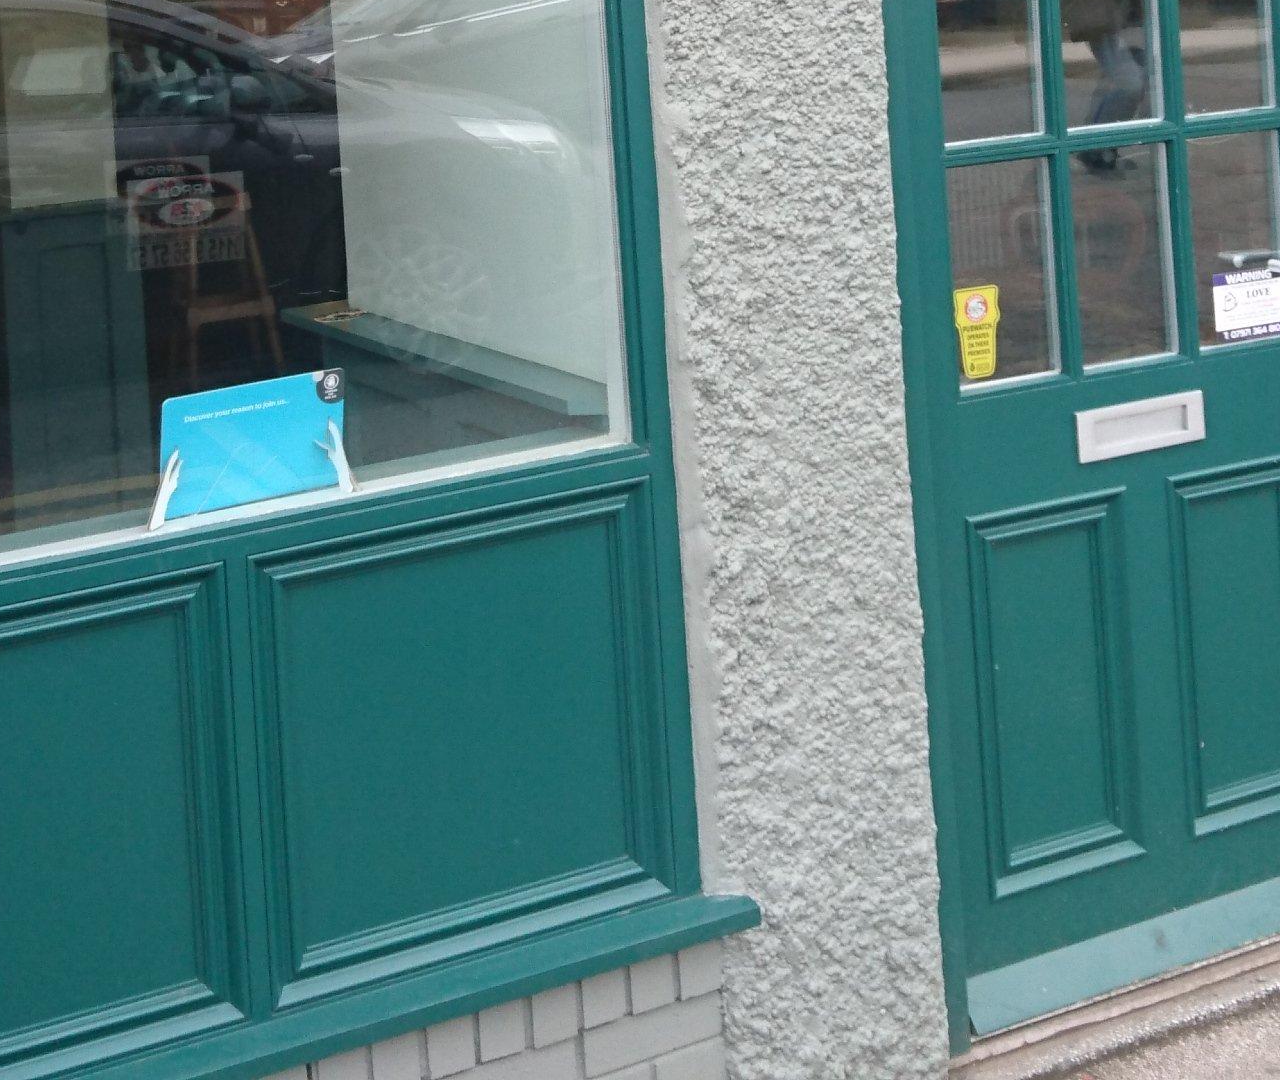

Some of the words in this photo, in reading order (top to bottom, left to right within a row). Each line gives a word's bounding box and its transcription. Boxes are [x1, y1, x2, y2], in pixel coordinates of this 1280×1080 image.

[1224, 269, 1273, 285] WARNING
[184, 411, 214, 423] Discover
[214, 409, 231, 419] your
[230, 404, 255, 415] reason
[262, 400, 276, 410] join
